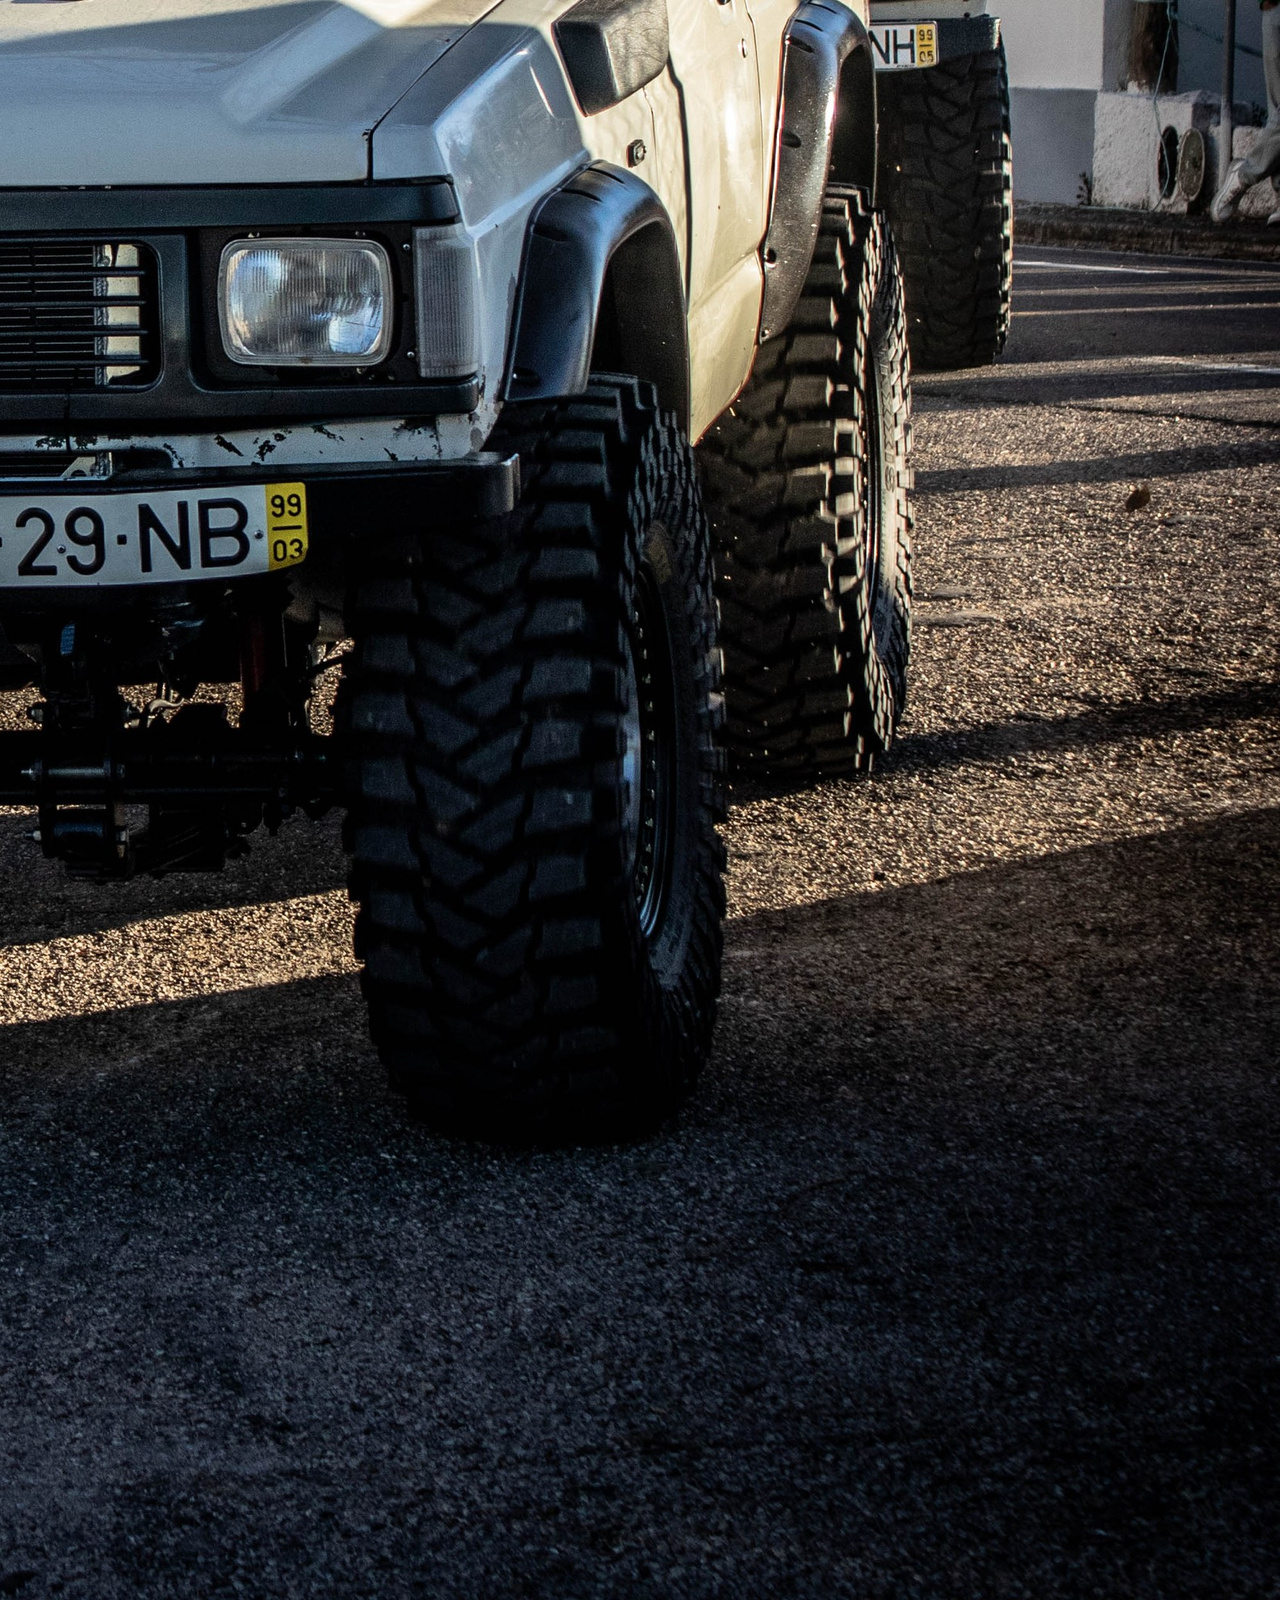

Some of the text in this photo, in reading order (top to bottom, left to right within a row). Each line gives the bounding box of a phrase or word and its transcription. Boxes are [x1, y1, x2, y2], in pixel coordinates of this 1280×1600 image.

[868, 29, 916, 65] NH
[918, 29, 934, 41] 99
[270, 493, 302, 518] 99
[273, 538, 304, 562] 03
